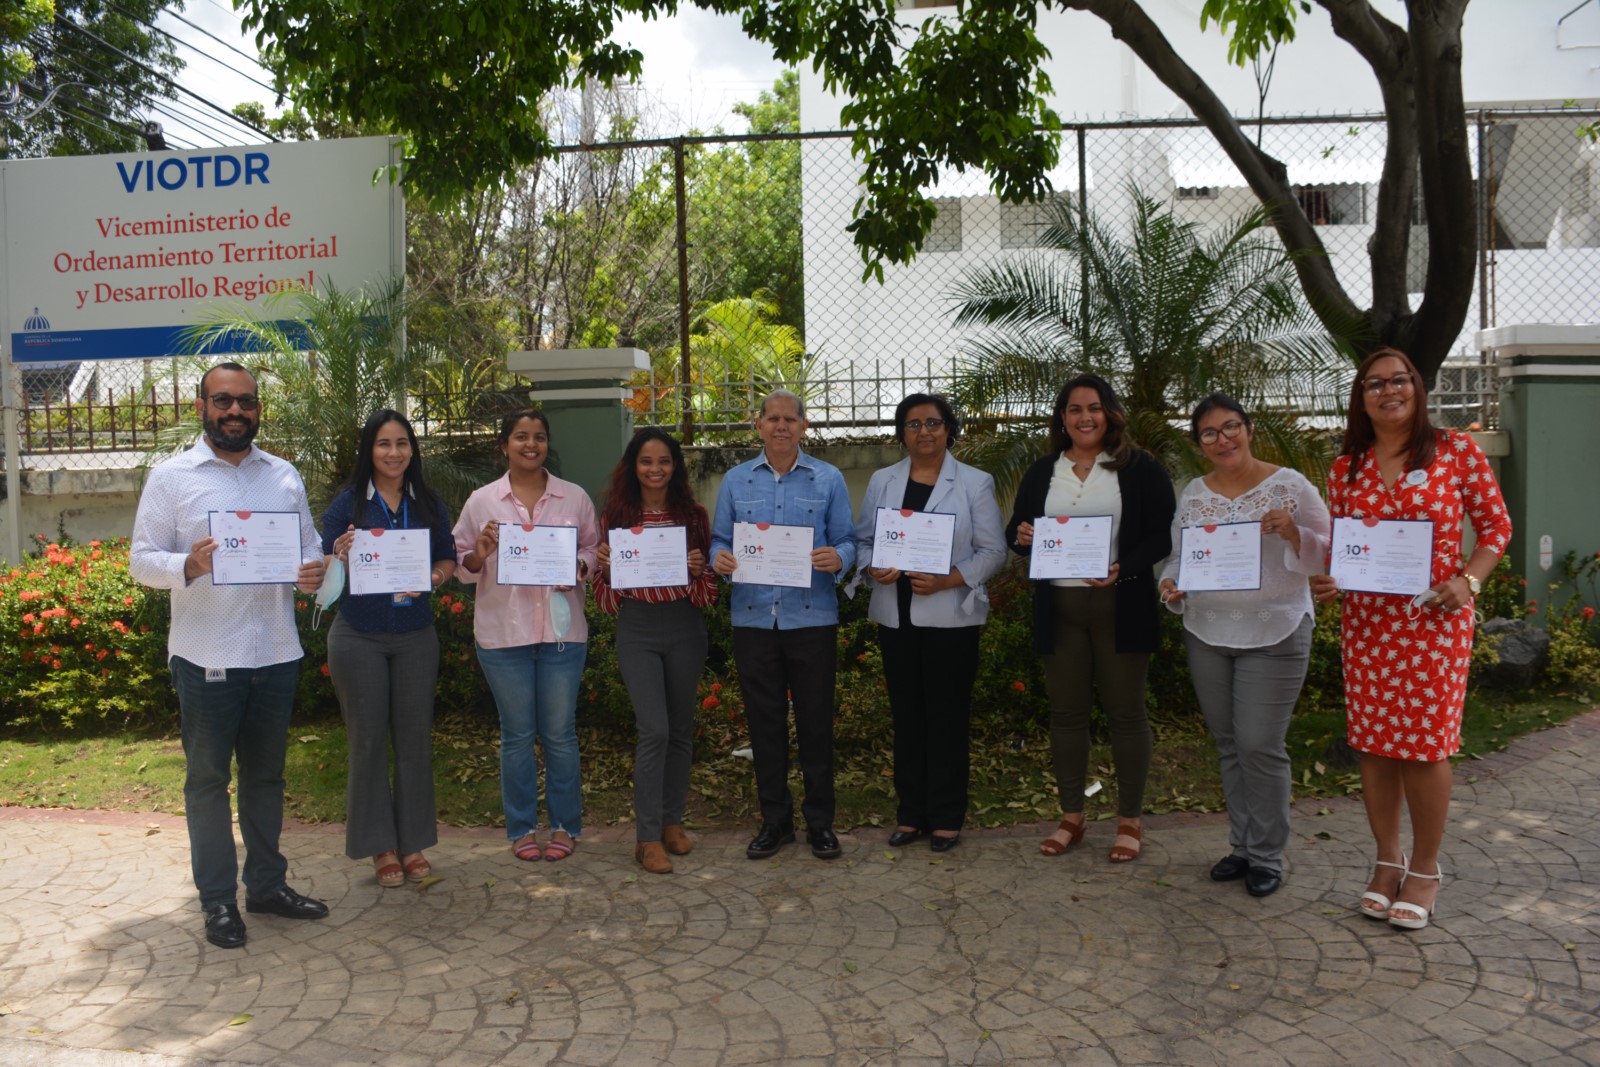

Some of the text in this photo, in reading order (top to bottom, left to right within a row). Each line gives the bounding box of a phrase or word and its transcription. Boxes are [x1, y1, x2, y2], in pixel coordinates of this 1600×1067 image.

[117, 152, 270, 193] VIOTDR
[96, 206, 292, 238] Viceministerio de
[53, 235, 337, 273] Ordenamiento Territorial
[76, 270, 314, 309] y Desarrollo Regional
